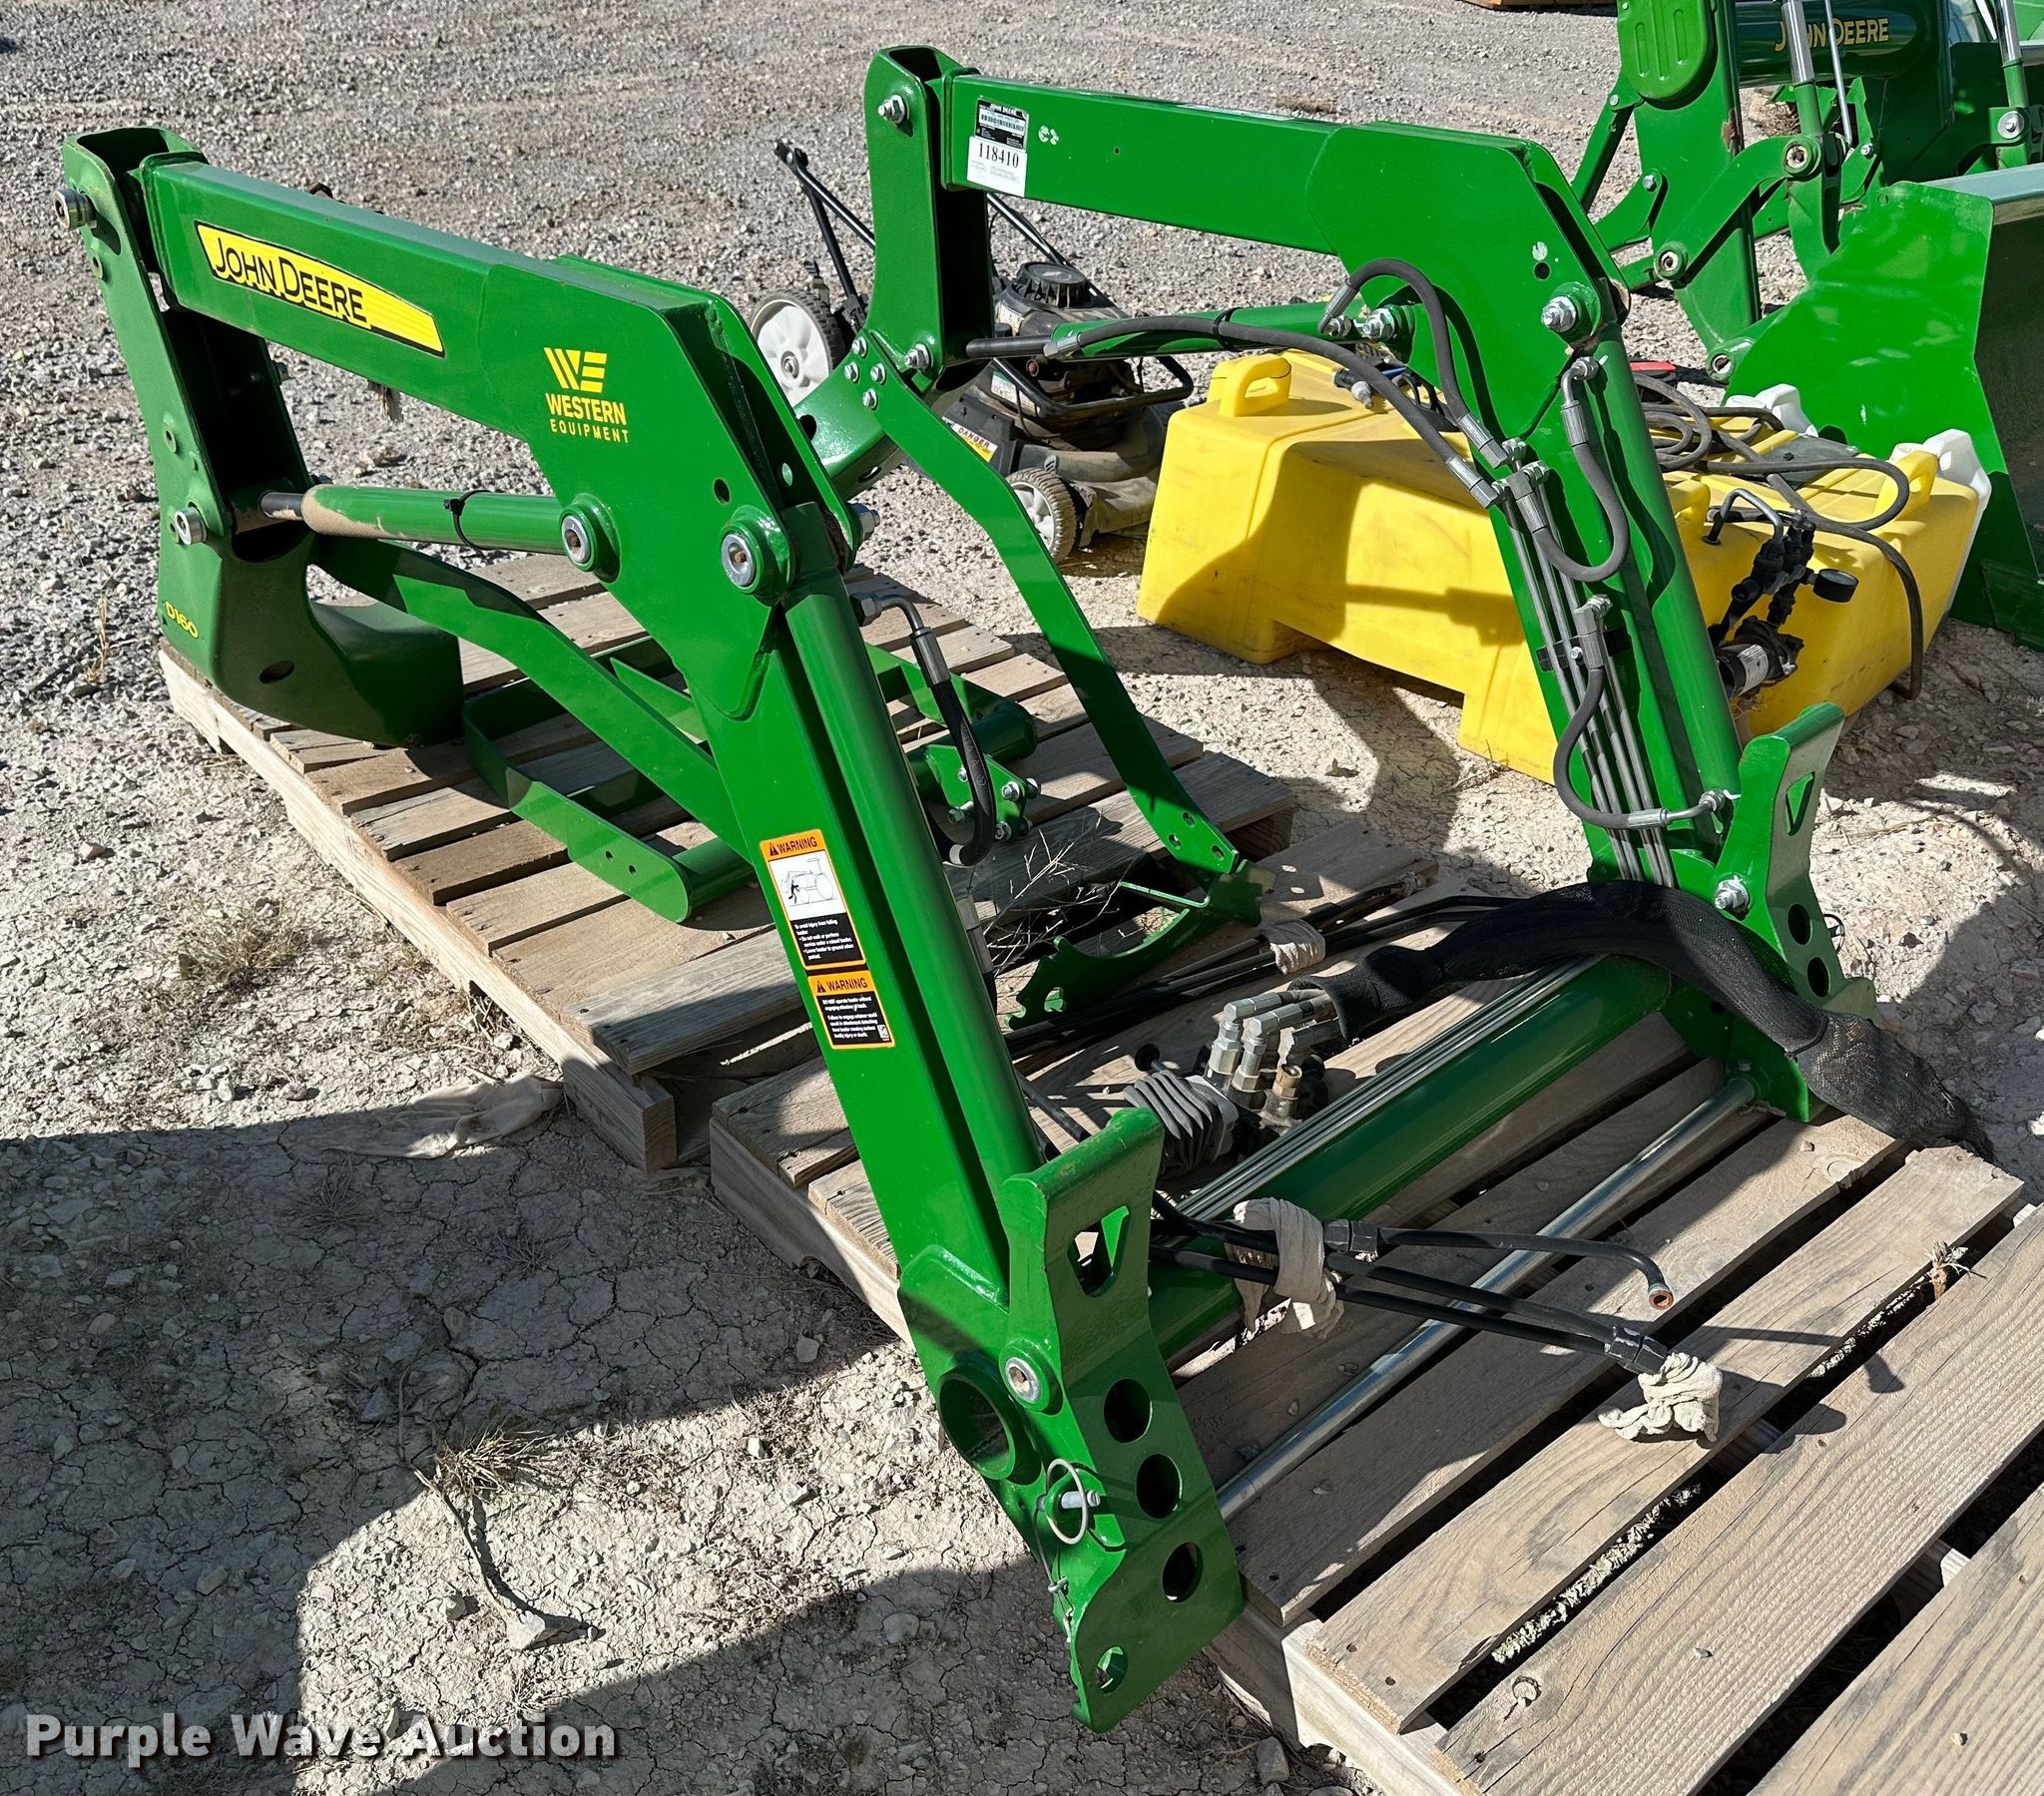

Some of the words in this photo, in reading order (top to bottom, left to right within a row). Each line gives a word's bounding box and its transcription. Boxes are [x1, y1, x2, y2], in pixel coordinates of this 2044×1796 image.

[1831, 17, 1889, 47] DEERE
[979, 143, 1019, 169] 118410
[216, 237, 277, 290] JOHN
[278, 256, 368, 323] DEERE
[545, 392, 627, 426] WESTERN
[550, 418, 629, 444] EQUIPMENT
[957, 427, 991, 449] DANGER
[165, 601, 199, 639] D160
[776, 836, 817, 855] WARNING
[826, 977, 868, 992] WARNING
